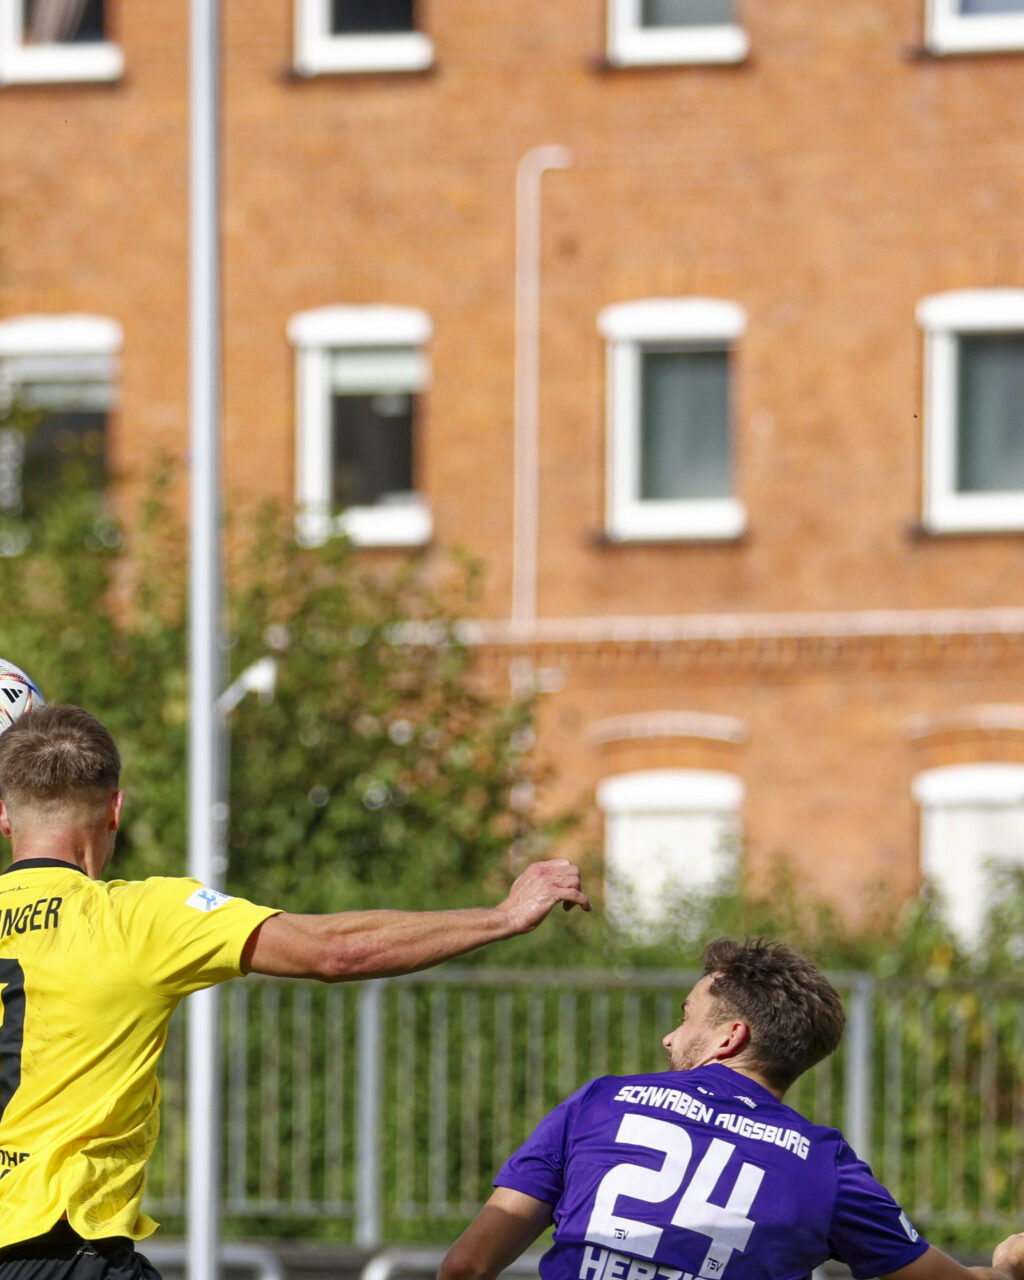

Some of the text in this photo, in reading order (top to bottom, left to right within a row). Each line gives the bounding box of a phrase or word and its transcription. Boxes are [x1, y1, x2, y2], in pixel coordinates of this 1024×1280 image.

[613, 1085, 714, 1125] SCHWABEN
[714, 1113, 811, 1160] AUGSBURG
[584, 1113, 766, 1280] 24
[613, 1227, 629, 1241] TSV
[706, 1257, 724, 1272] TSV
